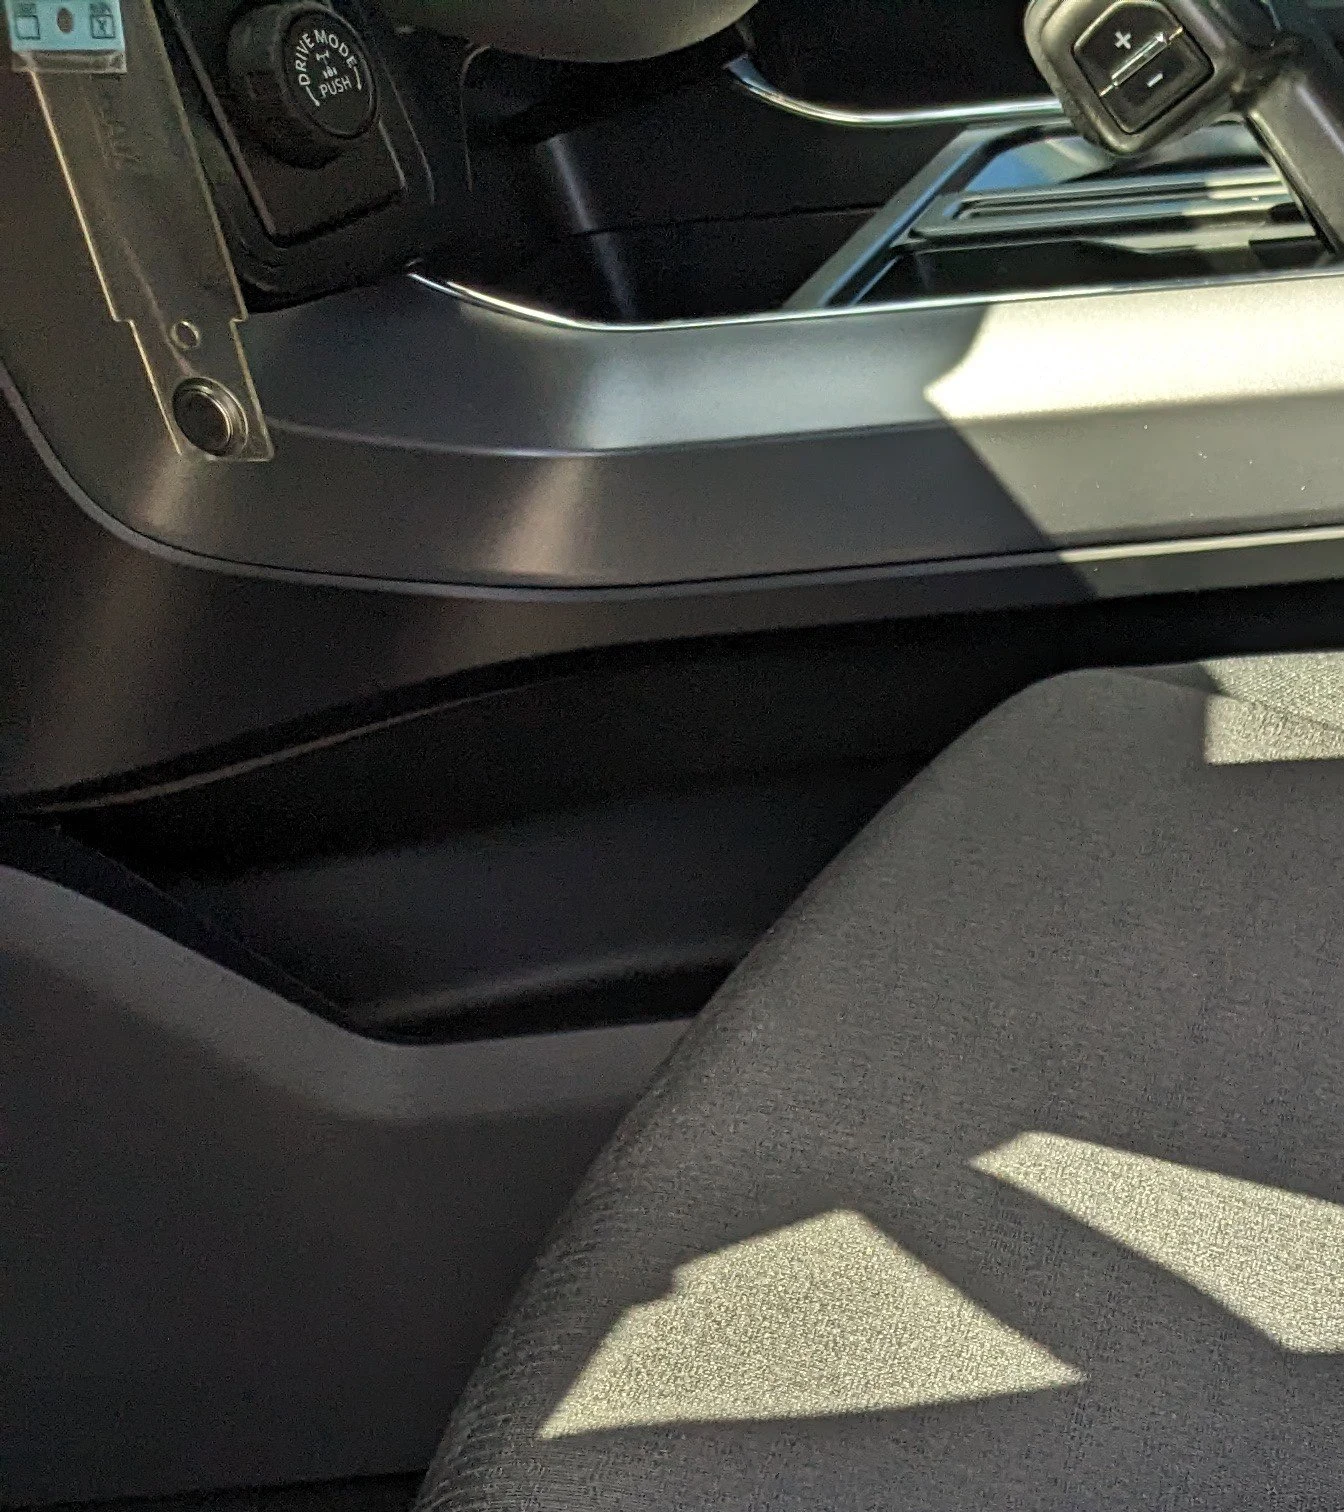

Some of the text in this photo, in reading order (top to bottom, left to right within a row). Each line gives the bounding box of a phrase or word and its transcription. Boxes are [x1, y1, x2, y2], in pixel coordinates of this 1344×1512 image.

[295, 29, 357, 86] DRIVE MODE
[319, 75, 353, 99] PUSH
